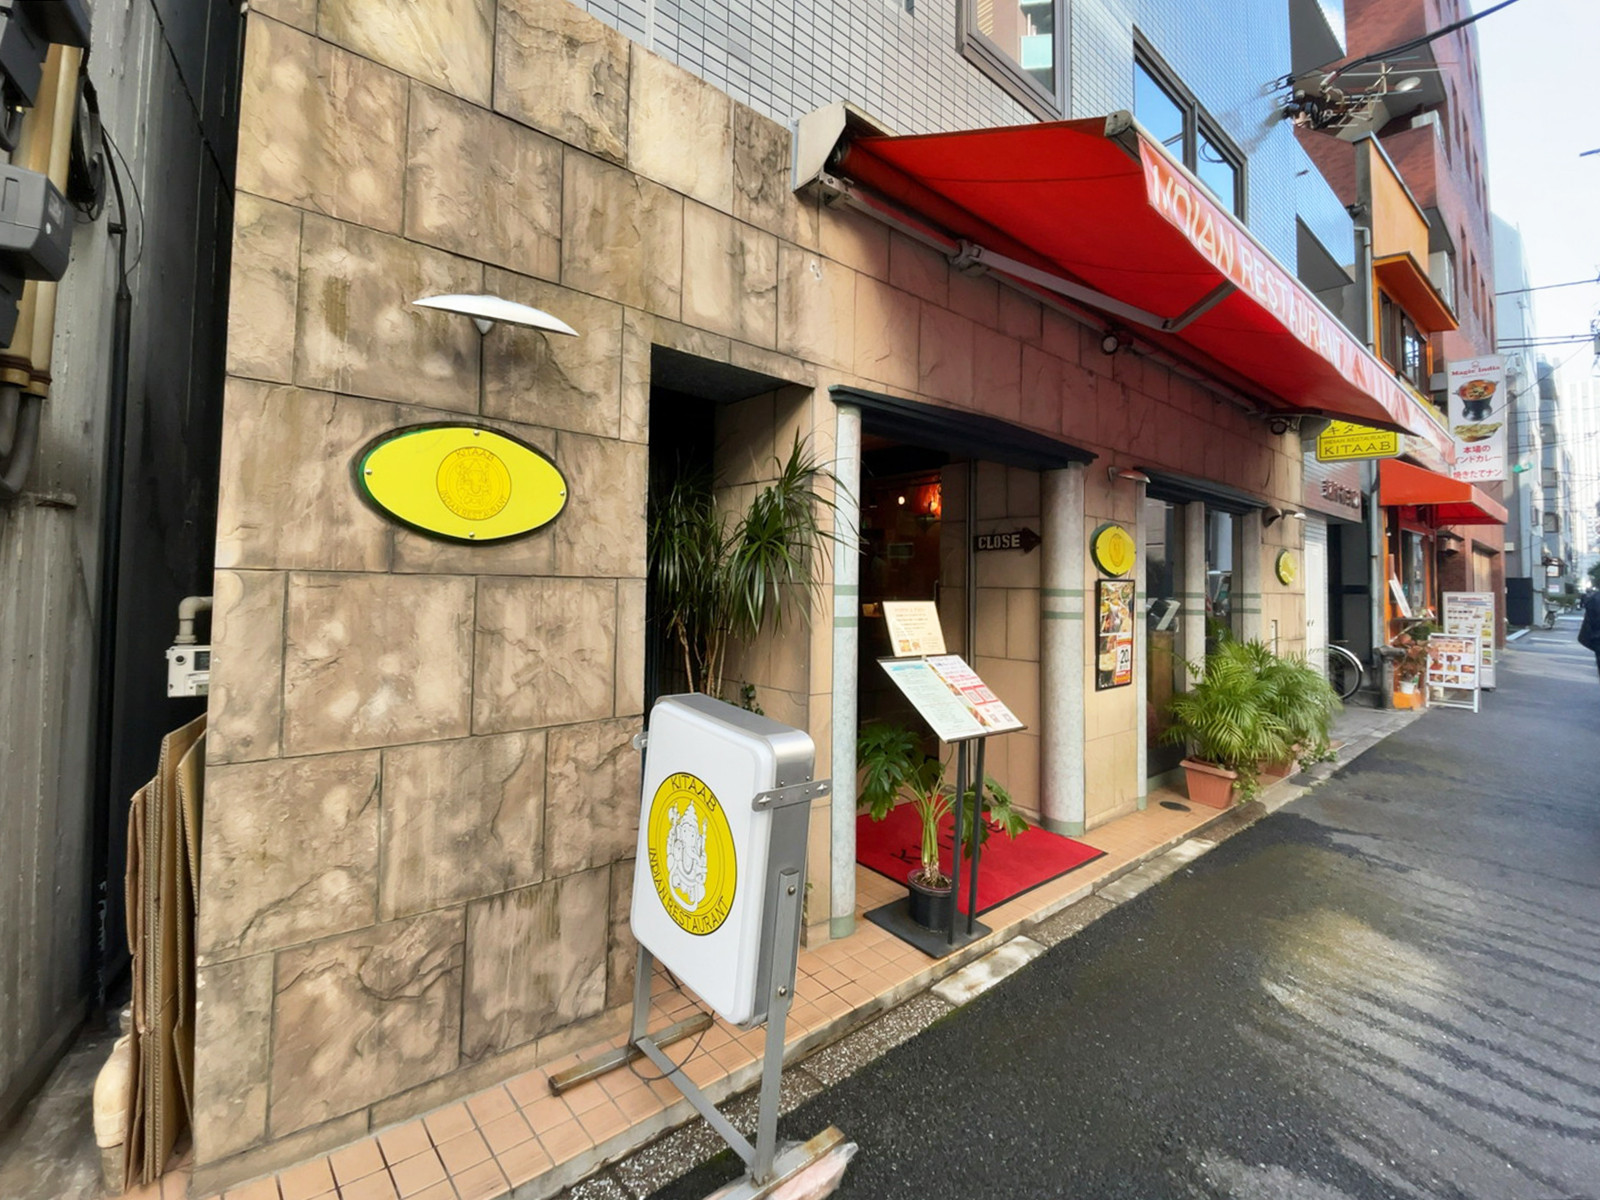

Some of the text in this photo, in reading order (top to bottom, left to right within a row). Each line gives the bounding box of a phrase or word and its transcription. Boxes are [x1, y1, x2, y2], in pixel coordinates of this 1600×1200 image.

[1240, 245, 1342, 367] RESTAURANT
[455, 448, 495, 461] KITAAB
[1324, 441, 1391, 455] KITAAB
[978, 534, 1021, 549] CLOSE
[670, 775, 717, 812] KITAAB
[648, 847, 729, 933] INDIAN RESTAURANT
